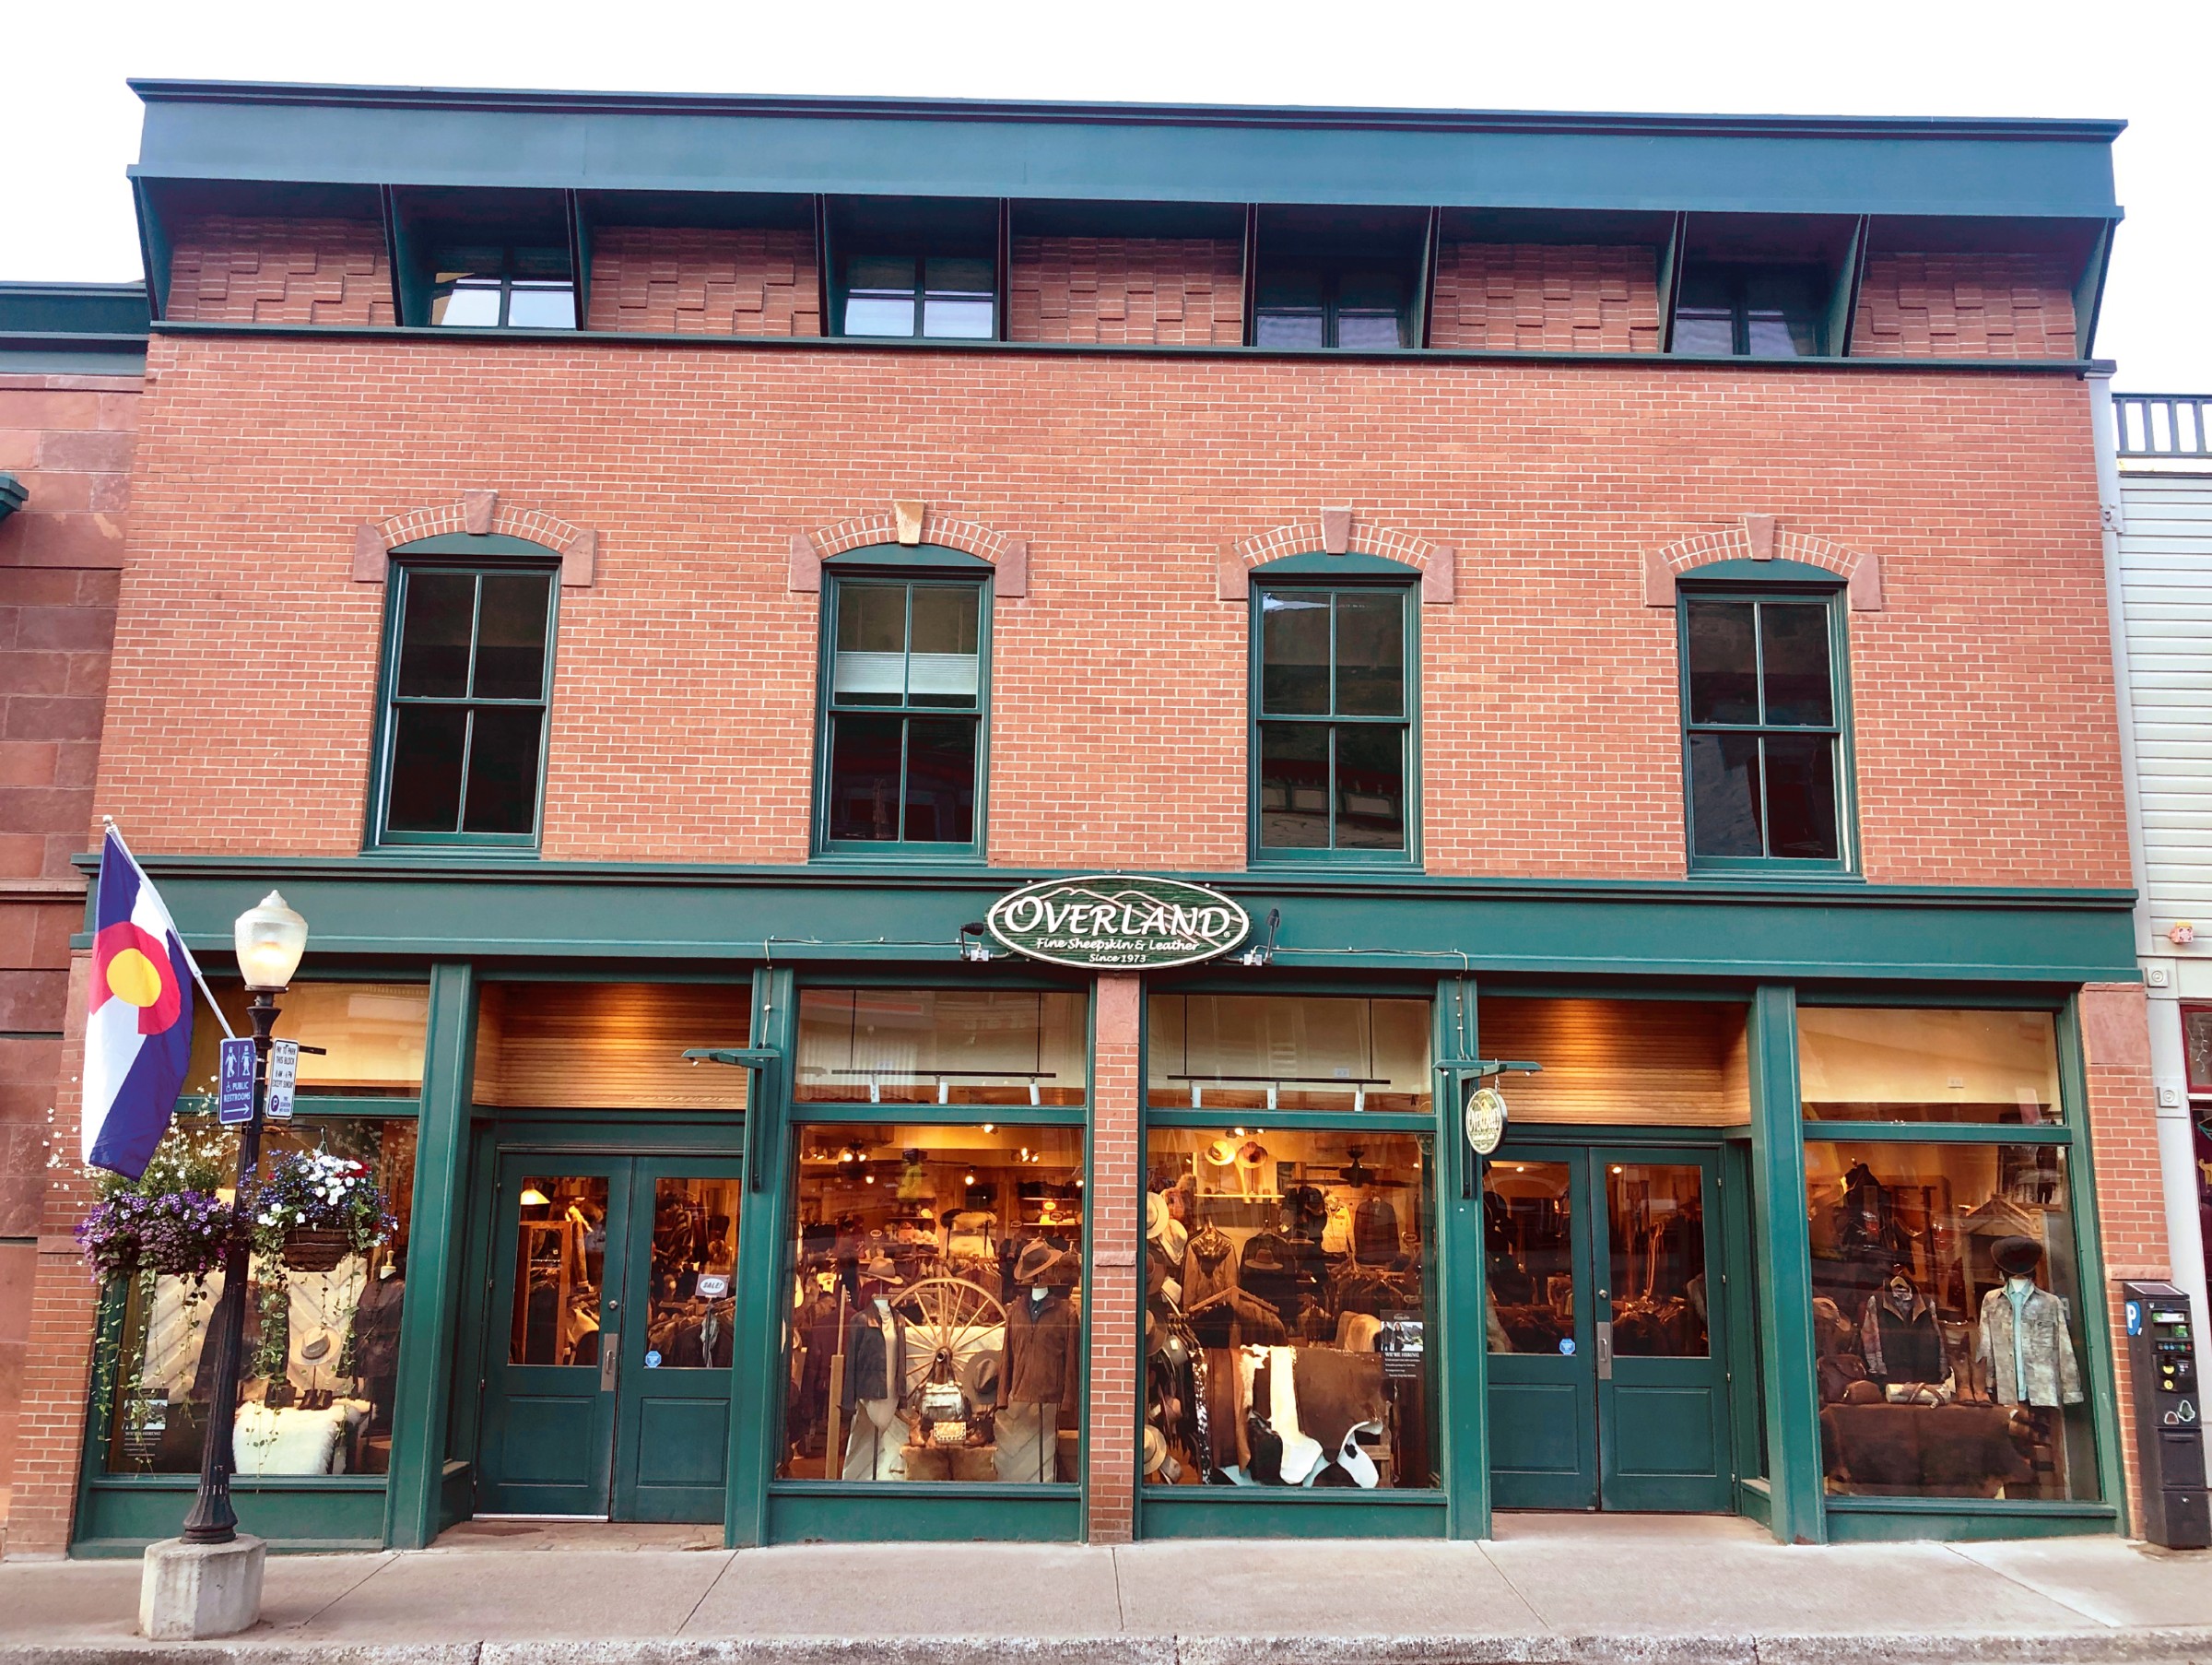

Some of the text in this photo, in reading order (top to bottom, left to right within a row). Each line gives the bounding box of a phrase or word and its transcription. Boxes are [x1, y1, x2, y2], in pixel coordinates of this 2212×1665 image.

[1004, 896, 1230, 938] OVERLAND
[1036, 938, 1200, 951] Fine Sheepskin & Leather
[1088, 953, 1147, 963] Since 1973
[284, 1057, 295, 1065] BLOCK
[232, 1081, 249, 1091] PUBLIC
[223, 1092, 251, 1103] RESTROOMS
[2125, 1304, 2137, 1328] P
